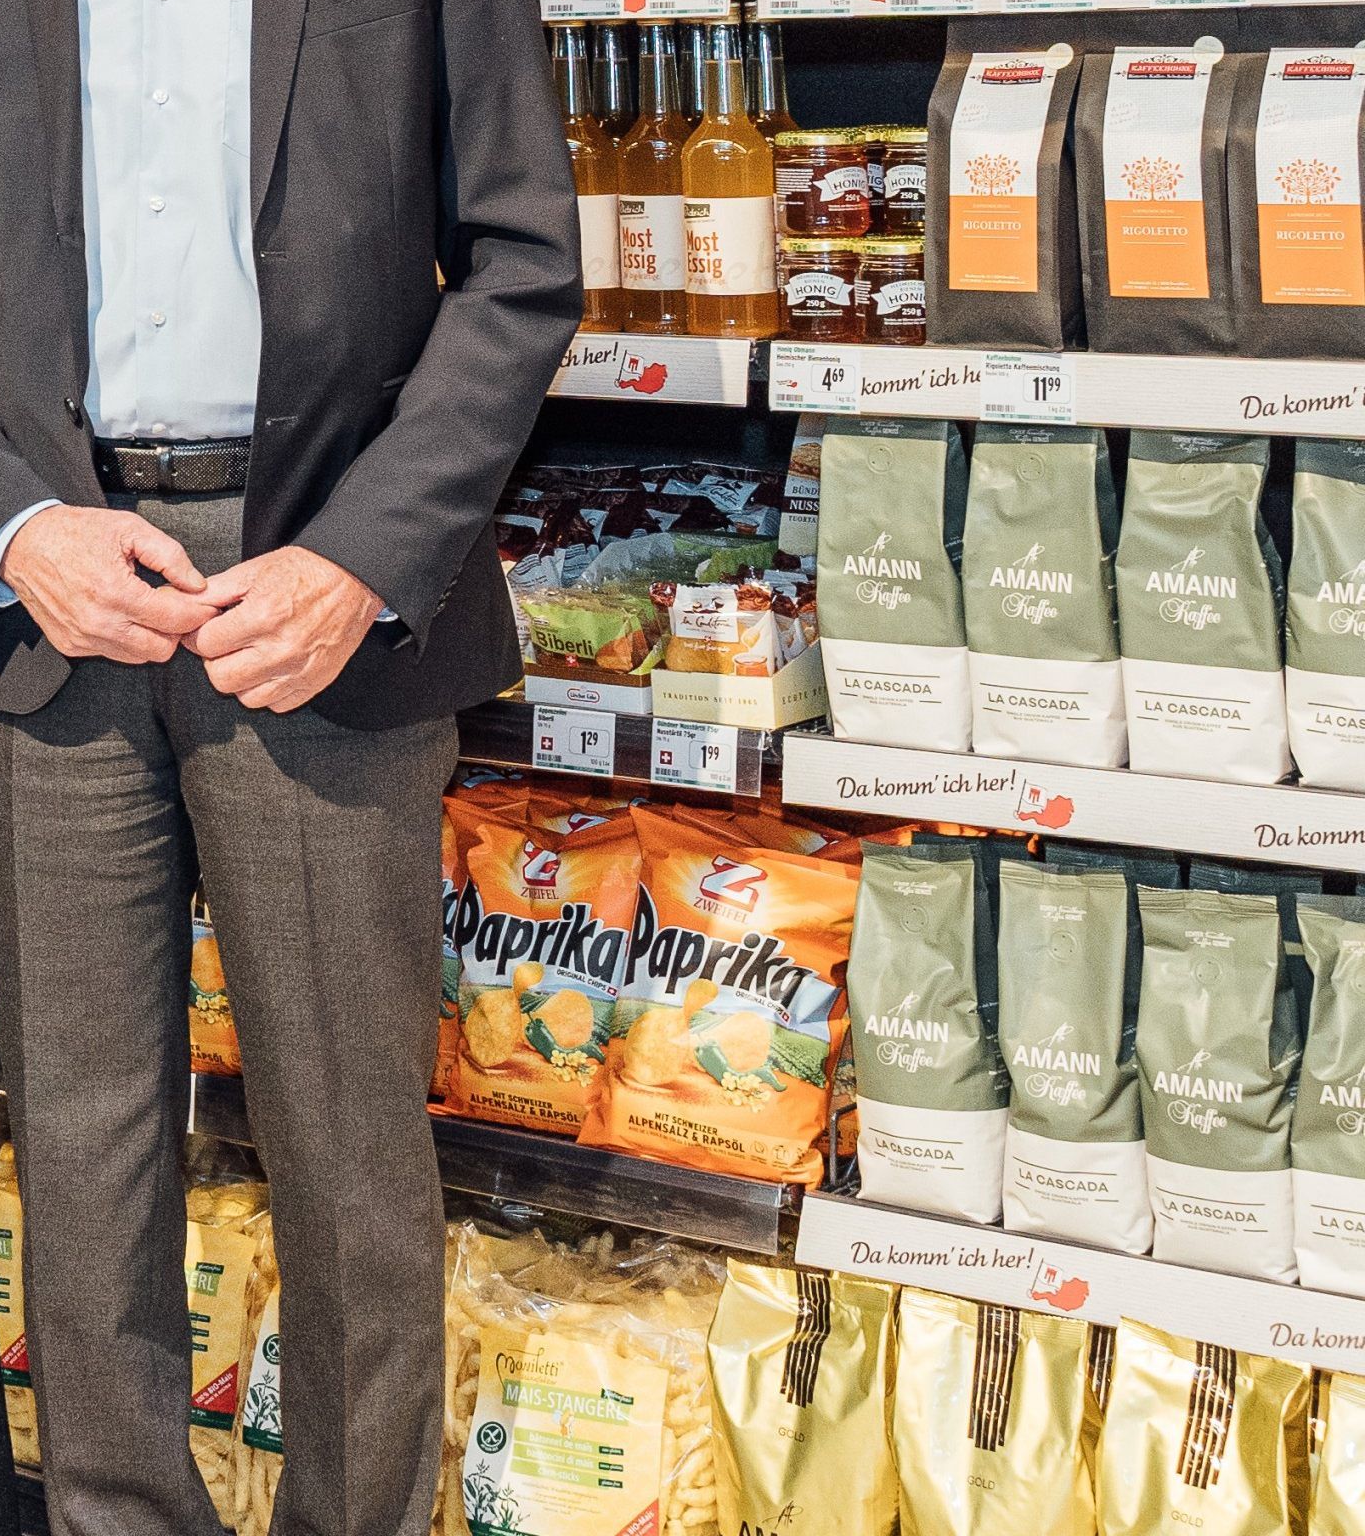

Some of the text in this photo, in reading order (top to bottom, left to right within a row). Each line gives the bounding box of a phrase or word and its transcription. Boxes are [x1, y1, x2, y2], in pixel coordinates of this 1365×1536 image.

[622, 226, 653, 248] Most
[963, 221, 1022, 232] RIGOLETTO
[1122, 225, 1188, 237] RIGOLETTO
[1275, 230, 1345, 241] RIGOLETTO
[686, 229, 719, 252] Most
[623, 247, 657, 275] Essig
[687, 251, 723, 279] Essig
[795, 284, 837, 296] HONIG
[582, 342, 618, 366] her!
[860, 368, 960, 397] komm' ich
[1239, 387, 1357, 419] Da komm'
[789, 500, 820, 513] NUSS
[842, 554, 922, 581] AMANN
[989, 566, 1073, 595] AMANN
[855, 578, 912, 611] Kaffee
[1144, 571, 1237, 599] AMANN
[1001, 592, 1058, 626] Kaffee
[1158, 596, 1221, 631] Kaffee
[535, 629, 594, 657] Biberli
[662, 692, 709, 702] TRADITION
[844, 677, 932, 695] LA CASCADA
[987, 692, 1080, 711] LA CASCADA
[1144, 699, 1242, 721] LA CASCADA
[1315, 712, 1333, 726] LA
[836, 769, 1016, 800] Da komm' ich her!
[1254, 824, 1295, 849] Da
[520, 885, 560, 901] ZWEIFEL
[693, 895, 751, 926] ZWEIFEL
[455, 874, 626, 984] Paprika
[625, 882, 812, 1008] Paprika
[556, 967, 607, 992] ORIGINAL CHIPS
[864, 1015, 949, 1044] AMANN
[876, 1039, 934, 1074] Kaffee
[1012, 1044, 1101, 1076] AMANN
[491, 1090, 553, 1110] MIT SCHWEIZER
[1024, 1072, 1087, 1107] Kaffee
[1153, 1070, 1243, 1104] AMANN
[470, 1093, 526, 1115] ALPENSALZ
[538, 1106, 581, 1124] RAPSÖL
[1167, 1099, 1228, 1135] Kaffee
[628, 1114, 689, 1140] ALPENSALZ
[701, 1130, 746, 1153] RAPSÖL
[654, 1111, 718, 1136] MIT SCHWEIZER
[875, 1137, 955, 1161] LA CASCADA
[1018, 1167, 1109, 1193] LA CASCADA
[1161, 1198, 1257, 1224] LA CASCADA
[1319, 1215, 1339, 1228] LA
[850, 1241, 1035, 1270] Da komm' ich her!
[1269, 1322, 1308, 1348] Da
[505, 1383, 625, 1421] MAIS-STANGERL
[777, 1427, 806, 1444] GOLD
[967, 1474, 997, 1491] GOLD
[1170, 1509, 1205, 1529] GOLD
